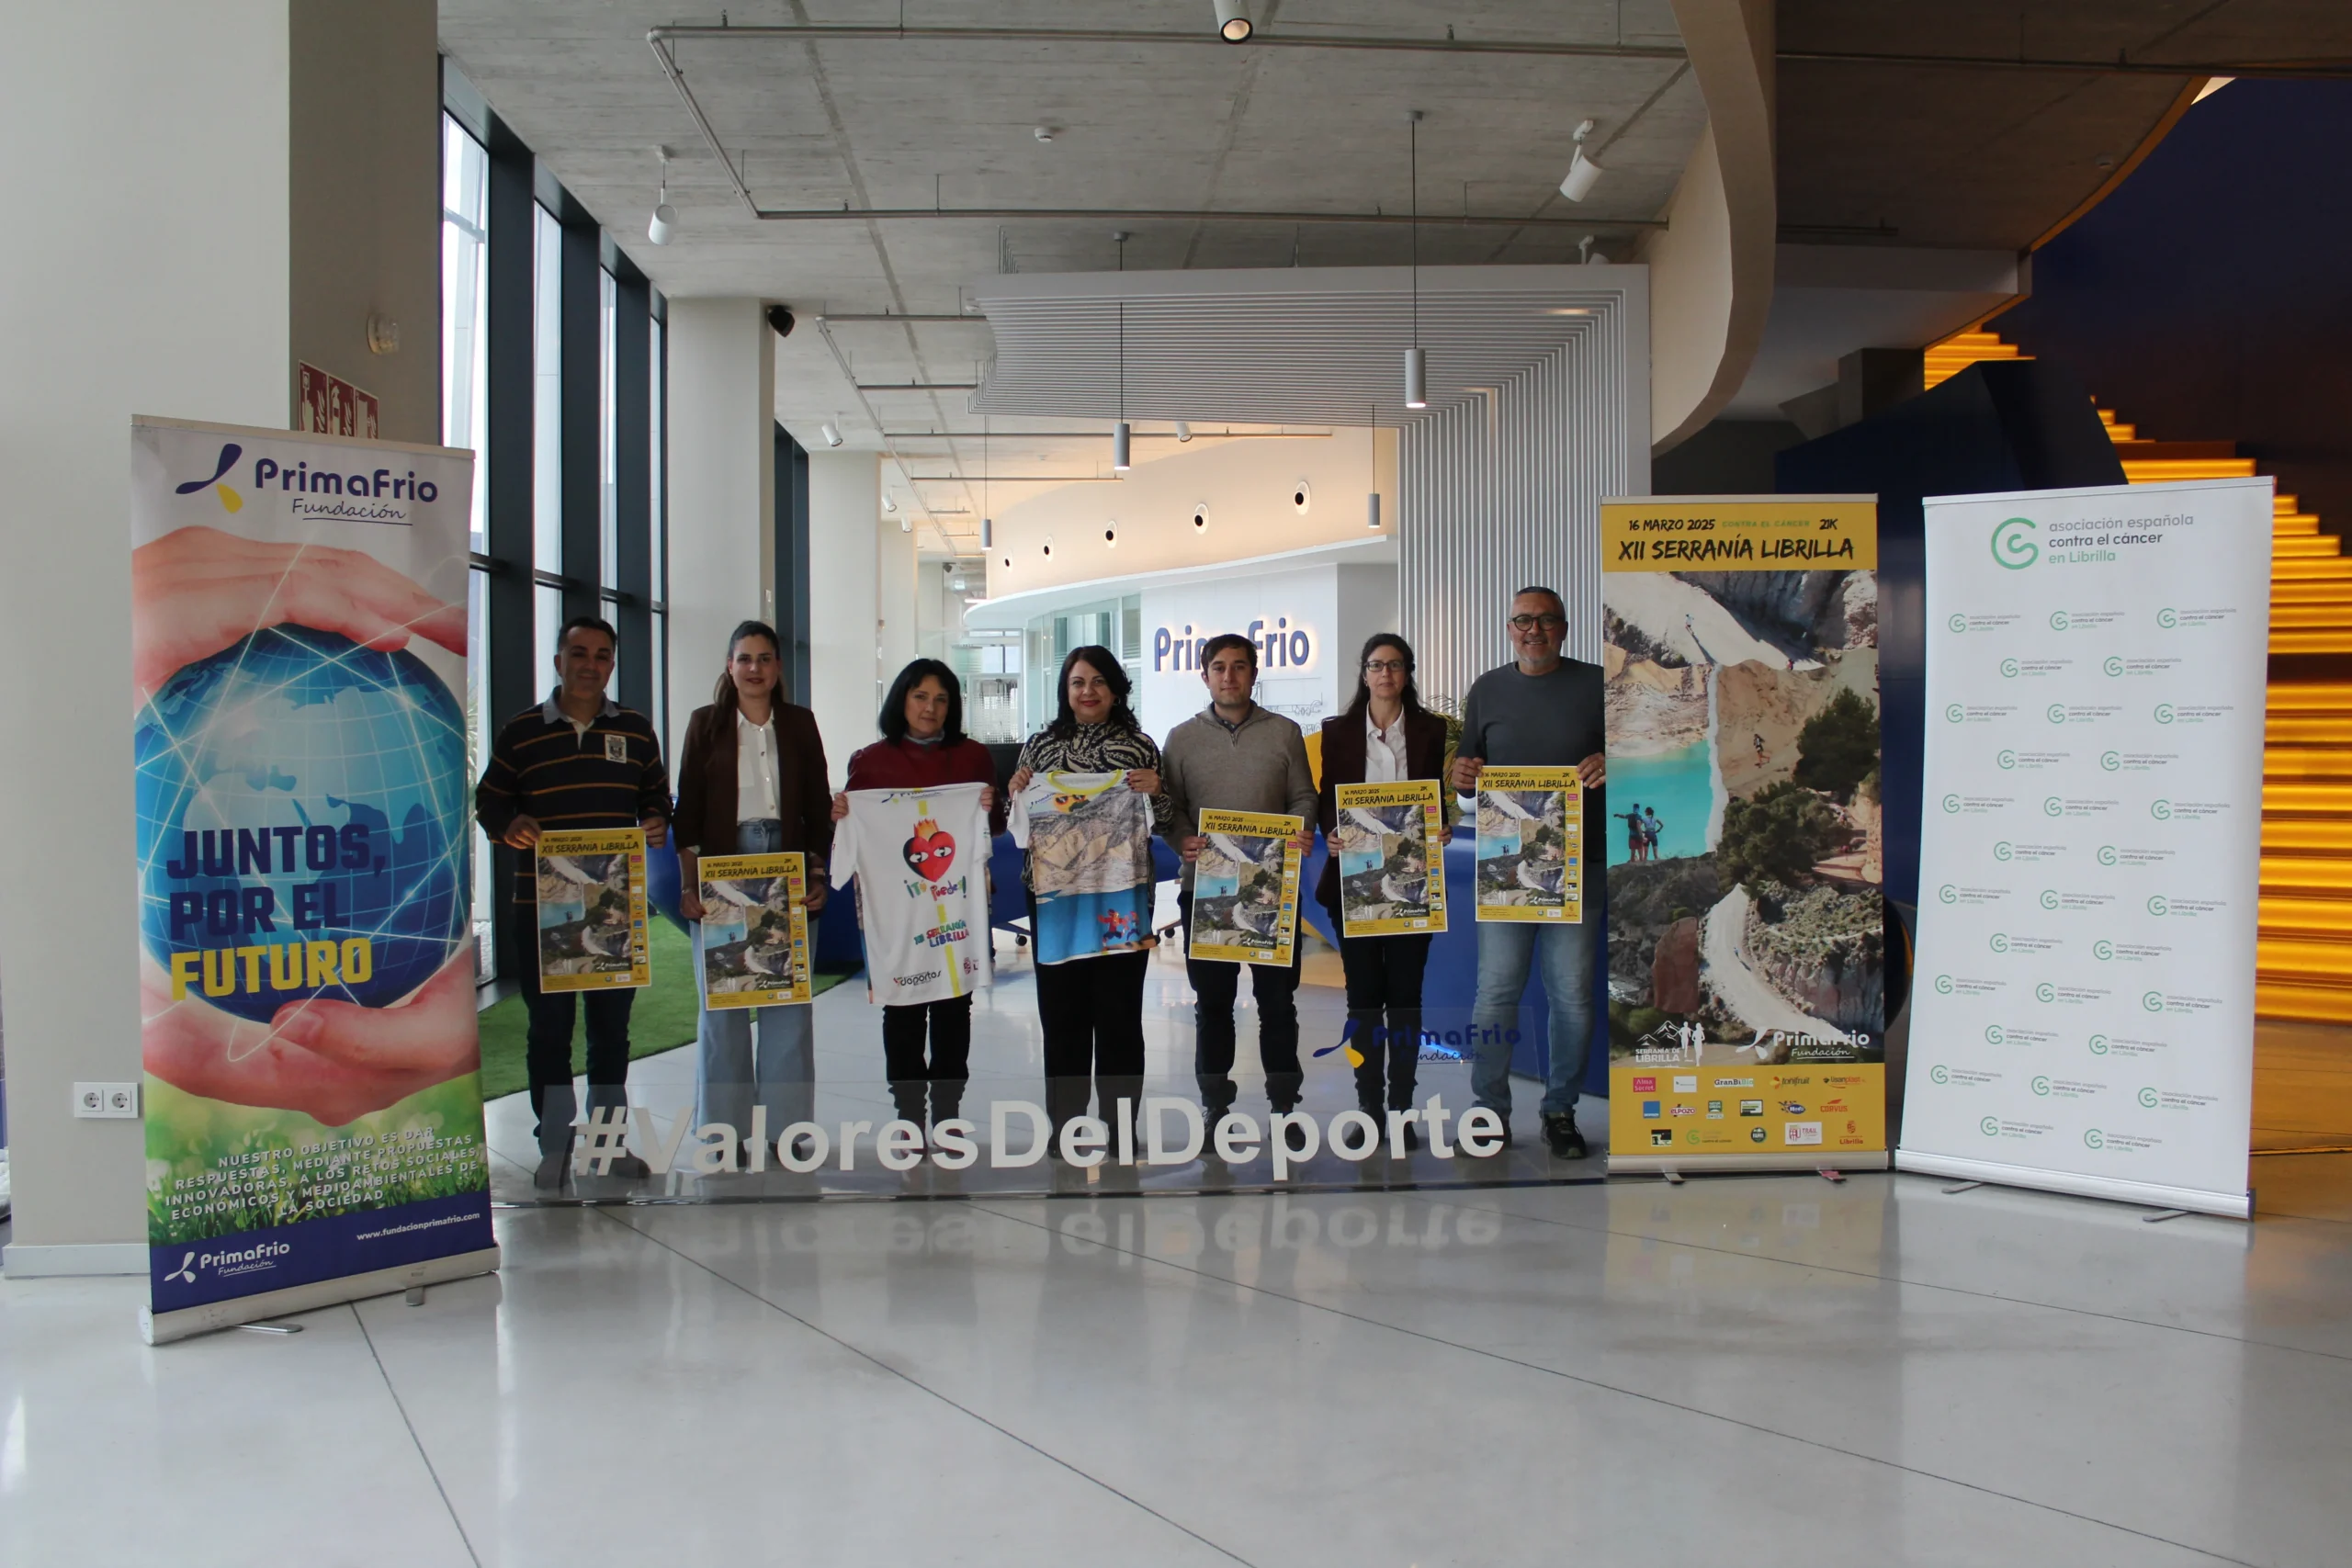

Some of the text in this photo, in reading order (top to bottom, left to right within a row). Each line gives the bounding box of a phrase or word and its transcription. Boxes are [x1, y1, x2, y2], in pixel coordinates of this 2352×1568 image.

[254, 457, 438, 503] PrimaFrio
[291, 498, 407, 520] Fundación
[1628, 519, 1640, 531] 16
[1643, 519, 1684, 532] MARZO
[1687, 518, 1715, 531] 2025
[1774, 519, 1810, 527] CÁNCER
[2049, 513, 2194, 533] asociación española
[1618, 534, 1854, 561] XII SERRANÍA LIBRILLA
[2049, 530, 2163, 548] contra el cáncer
[2049, 549, 2116, 564] en Librilla
[1154, 617, 1310, 672] PriFrio
[1482, 778, 1576, 788] XII SERRANÍA LIBRILLA
[1342, 793, 1434, 806] XII SERRANÍA LIBRILLA
[1204, 822, 1216, 830] XII
[1217, 822, 1257, 833] SERRANÍA
[1260, 827, 1296, 836] LIBRILLA
[166, 823, 386, 879] JUNTOS,
[541, 840, 639, 853] XII SERRANÍA LIBRILLA
[705, 864, 798, 878] XII SERRANÍA LIBRILLA
[170, 882, 351, 941] POR EL
[929, 929, 969, 948] LIBRILLA
[170, 937, 372, 1001] FUTURO
[1373, 1023, 1521, 1047] PrimaFrio
[1400, 1048, 1487, 1062] ndación
[1635, 1055, 1680, 1063] LIBRILLA
[1791, 1047, 1851, 1056] Fundación
[218, 1126, 435, 1168] NUESTRO OBJETIVO ES DAR
[575, 1092, 1504, 1182] #ValoresDelDeporte
[175, 1134, 473, 1190] RESPUESTAS, MEDIANTE PROPUESTAS
[165, 1147, 481, 1206] INNOVADORAS, A LOS RETOS SOCIALES,
[171, 1160, 479, 1222] ECONÓMICOS Y MEDIOAMBIENTALES DE
[279, 1189, 385, 1217] LA SOCIEDAD
[356, 1211, 481, 1241] www.fundacionprimafrio.com
[199, 1240, 290, 1269] PrimaFrio
[217, 1258, 275, 1276] Fundación
